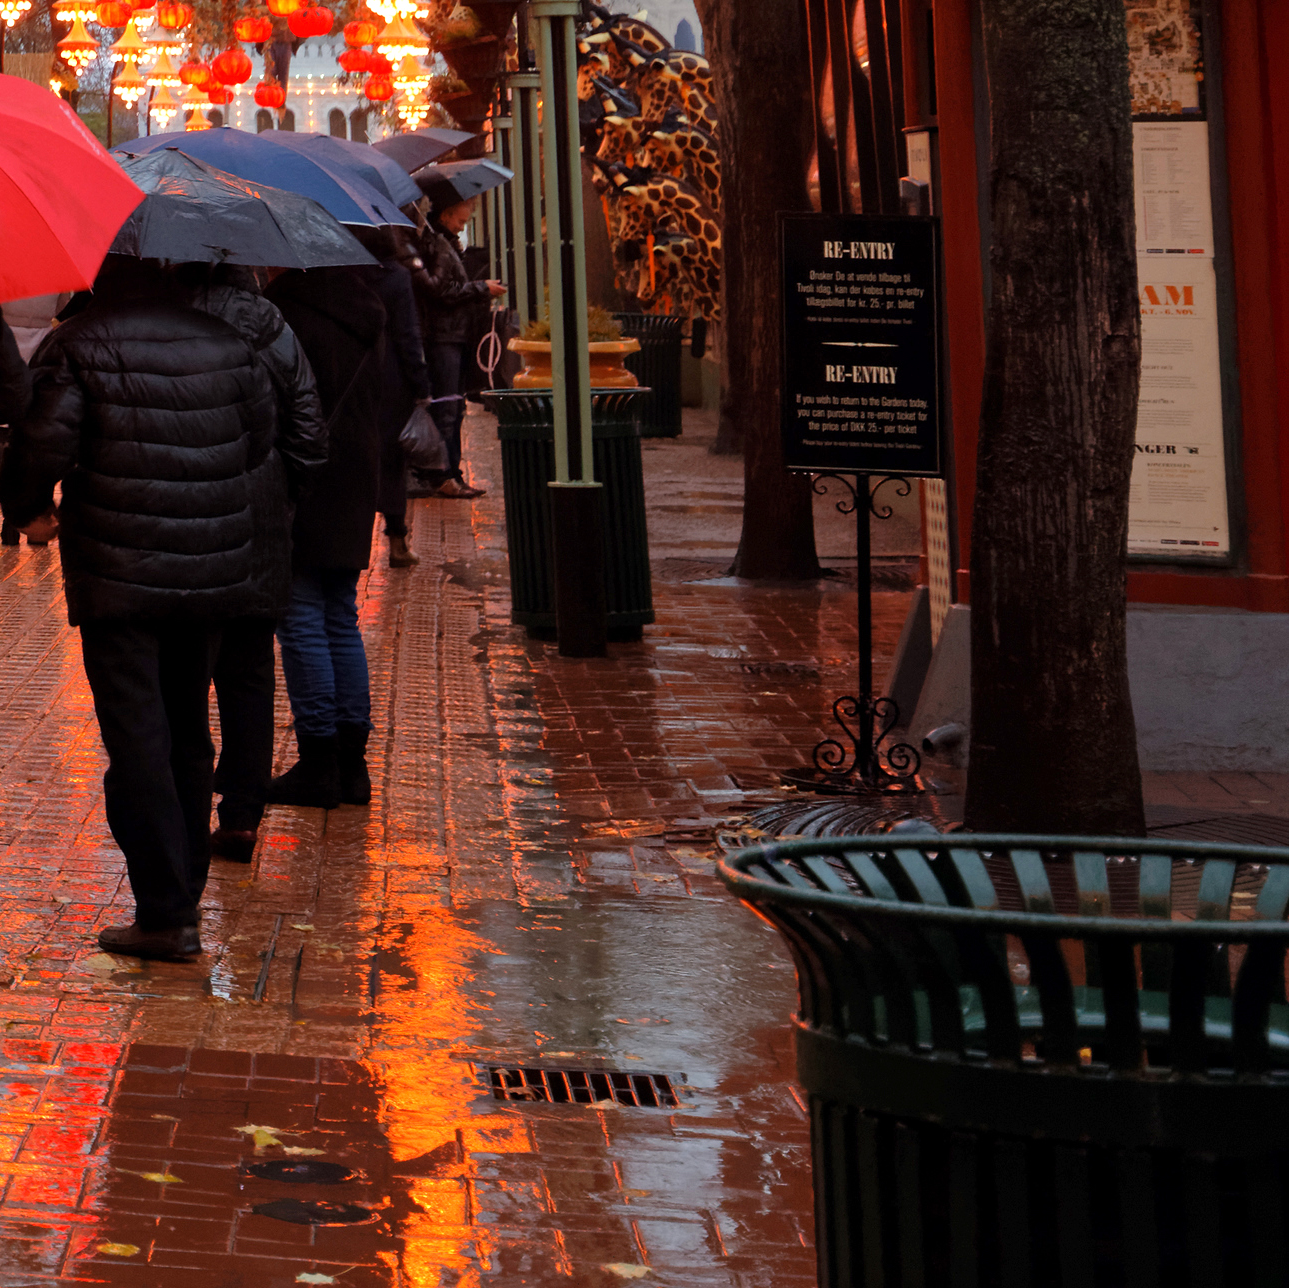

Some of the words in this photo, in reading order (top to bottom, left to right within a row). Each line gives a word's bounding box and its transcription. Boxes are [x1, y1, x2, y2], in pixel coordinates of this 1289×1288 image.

[823, 240, 895, 260] RE-ENTRY
[835, 271, 845, 281] De
[847, 272, 855, 281] at
[856, 272, 877, 282] vende
[879, 272, 902, 284] tilbage
[903, 273, 911, 283] til
[797, 282, 814, 293] Tivoli
[834, 285, 848, 293] kan
[849, 285, 861, 294] der
[896, 288, 924, 298] re-entry
[847, 298, 856, 307] for
[898, 299, 915, 309] billet
[825, 364, 898, 384] RE-ENTRY
[796, 393, 802, 403] If
[802, 396, 814, 405] you
[816, 395, 831, 405] wish
[832, 396, 839, 405] to
[840, 396, 860, 406] return
[861, 397, 868, 406] to
[869, 396, 880, 406] the
[881, 396, 908, 408] Gardens
[797, 409, 810, 418] you
[812, 409, 825, 417] can
[827, 409, 859, 419] purchase
[860, 411, 865, 419] a
[867, 411, 895, 421] re-entry
[896, 411, 916, 421] ticket
[918, 411, 928, 421] for
[808, 421, 820, 430] the
[822, 422, 839, 432] price
[841, 422, 848, 431] of
[850, 422, 865, 432] DKK
[884, 425, 896, 434] per
[897, 425, 917, 434] ticket
